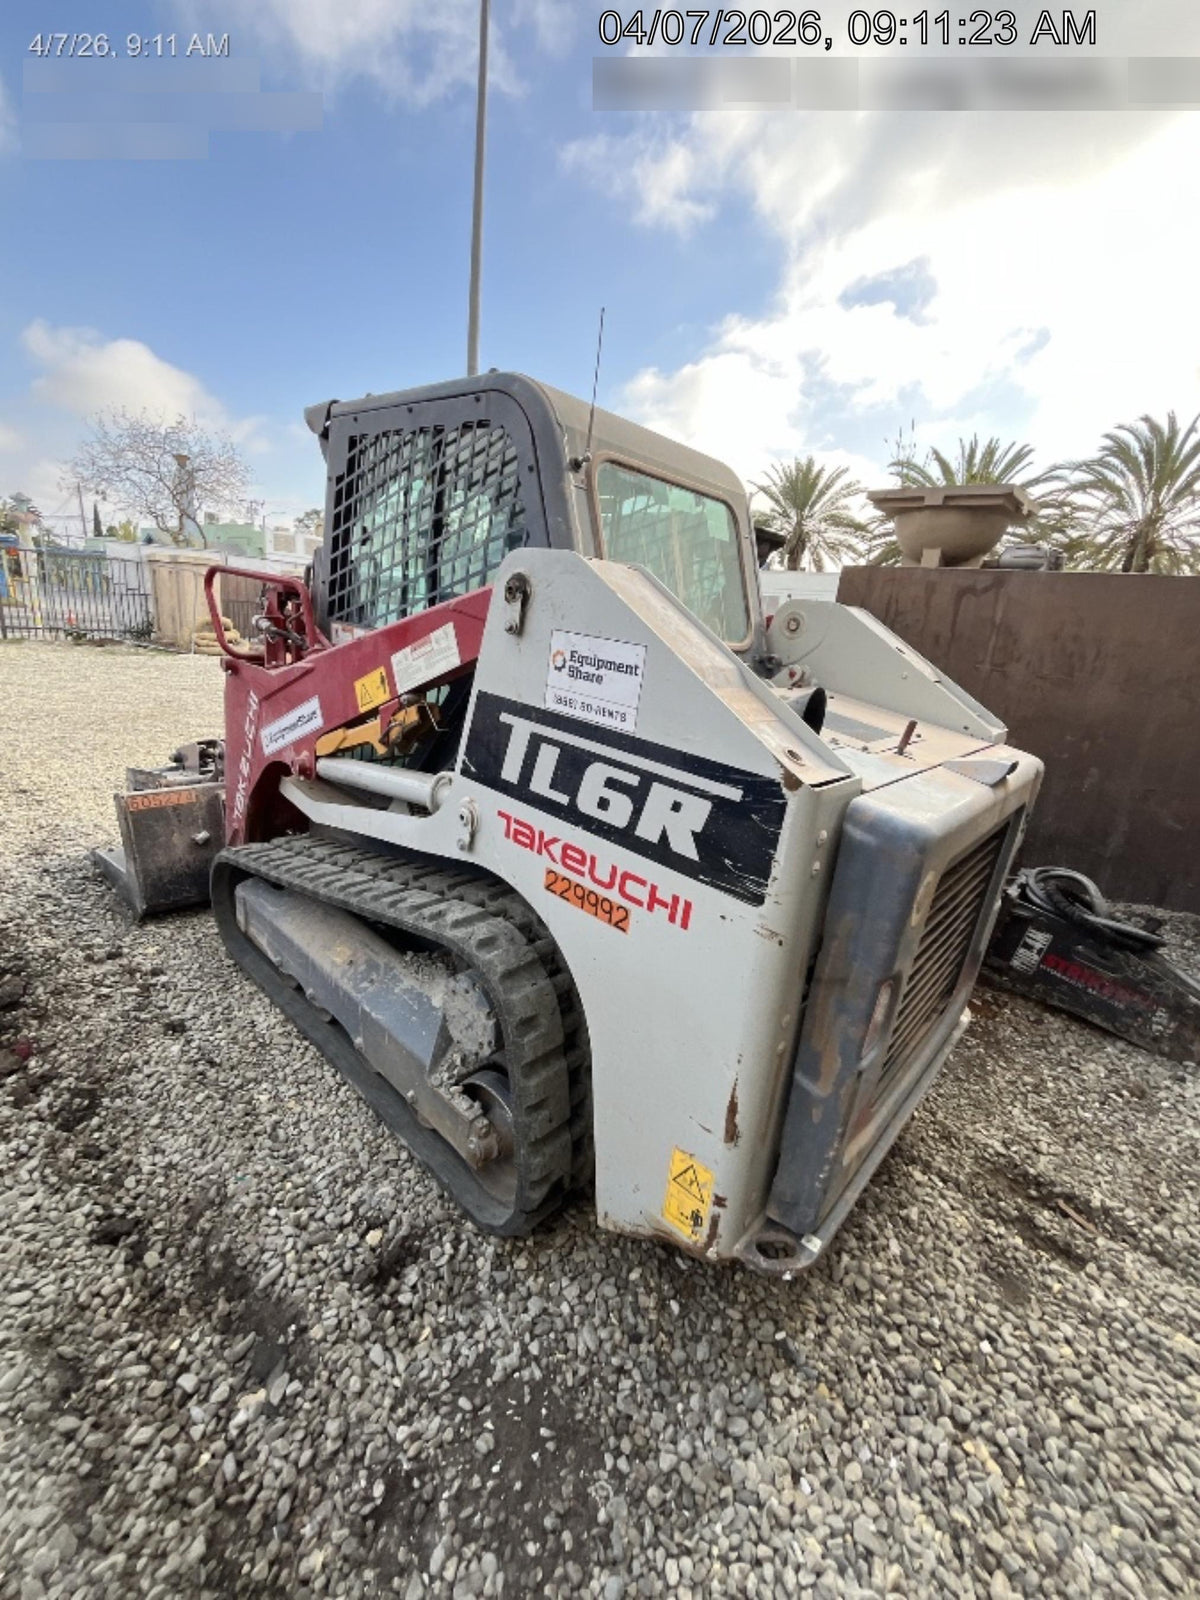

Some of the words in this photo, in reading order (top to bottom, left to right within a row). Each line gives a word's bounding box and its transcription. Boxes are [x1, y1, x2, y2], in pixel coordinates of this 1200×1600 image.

[568, 665, 604, 685] Share
[569, 650, 640, 676] Equipment
[499, 712, 743, 861] TL6R
[544, 868, 630, 933] 229992
